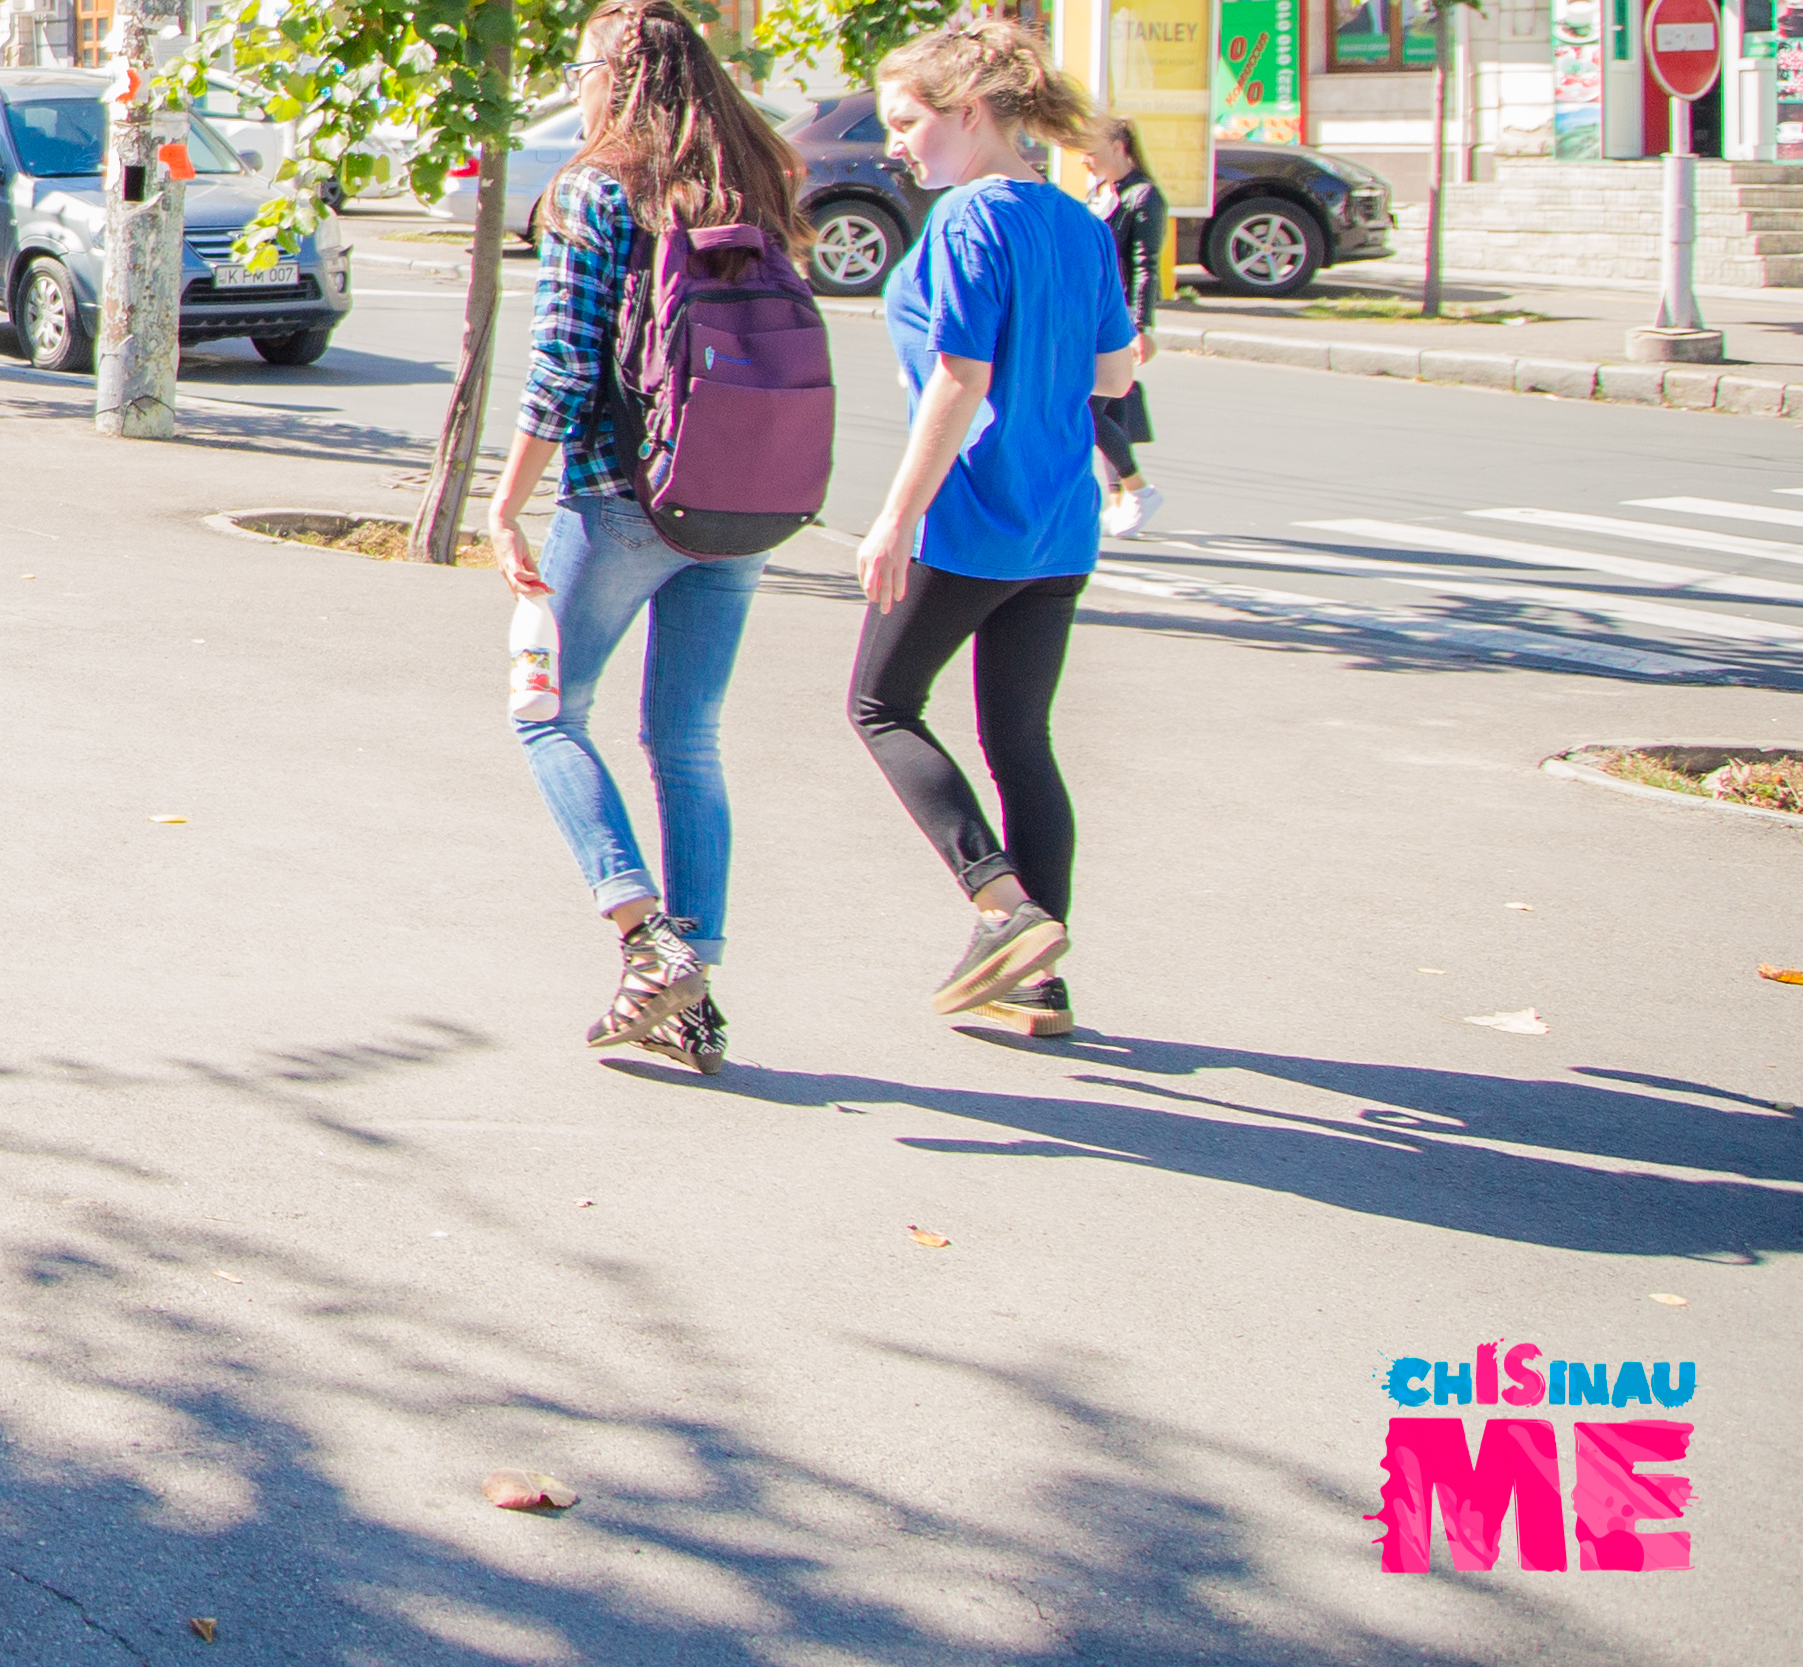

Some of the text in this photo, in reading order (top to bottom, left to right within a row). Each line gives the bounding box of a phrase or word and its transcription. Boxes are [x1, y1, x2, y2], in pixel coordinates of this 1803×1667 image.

[1276, 0, 1293, 32] 010
[1113, 19, 1198, 42] STANLEY
[1276, 33, 1293, 66] 010
[269, 266, 294, 283] 007
